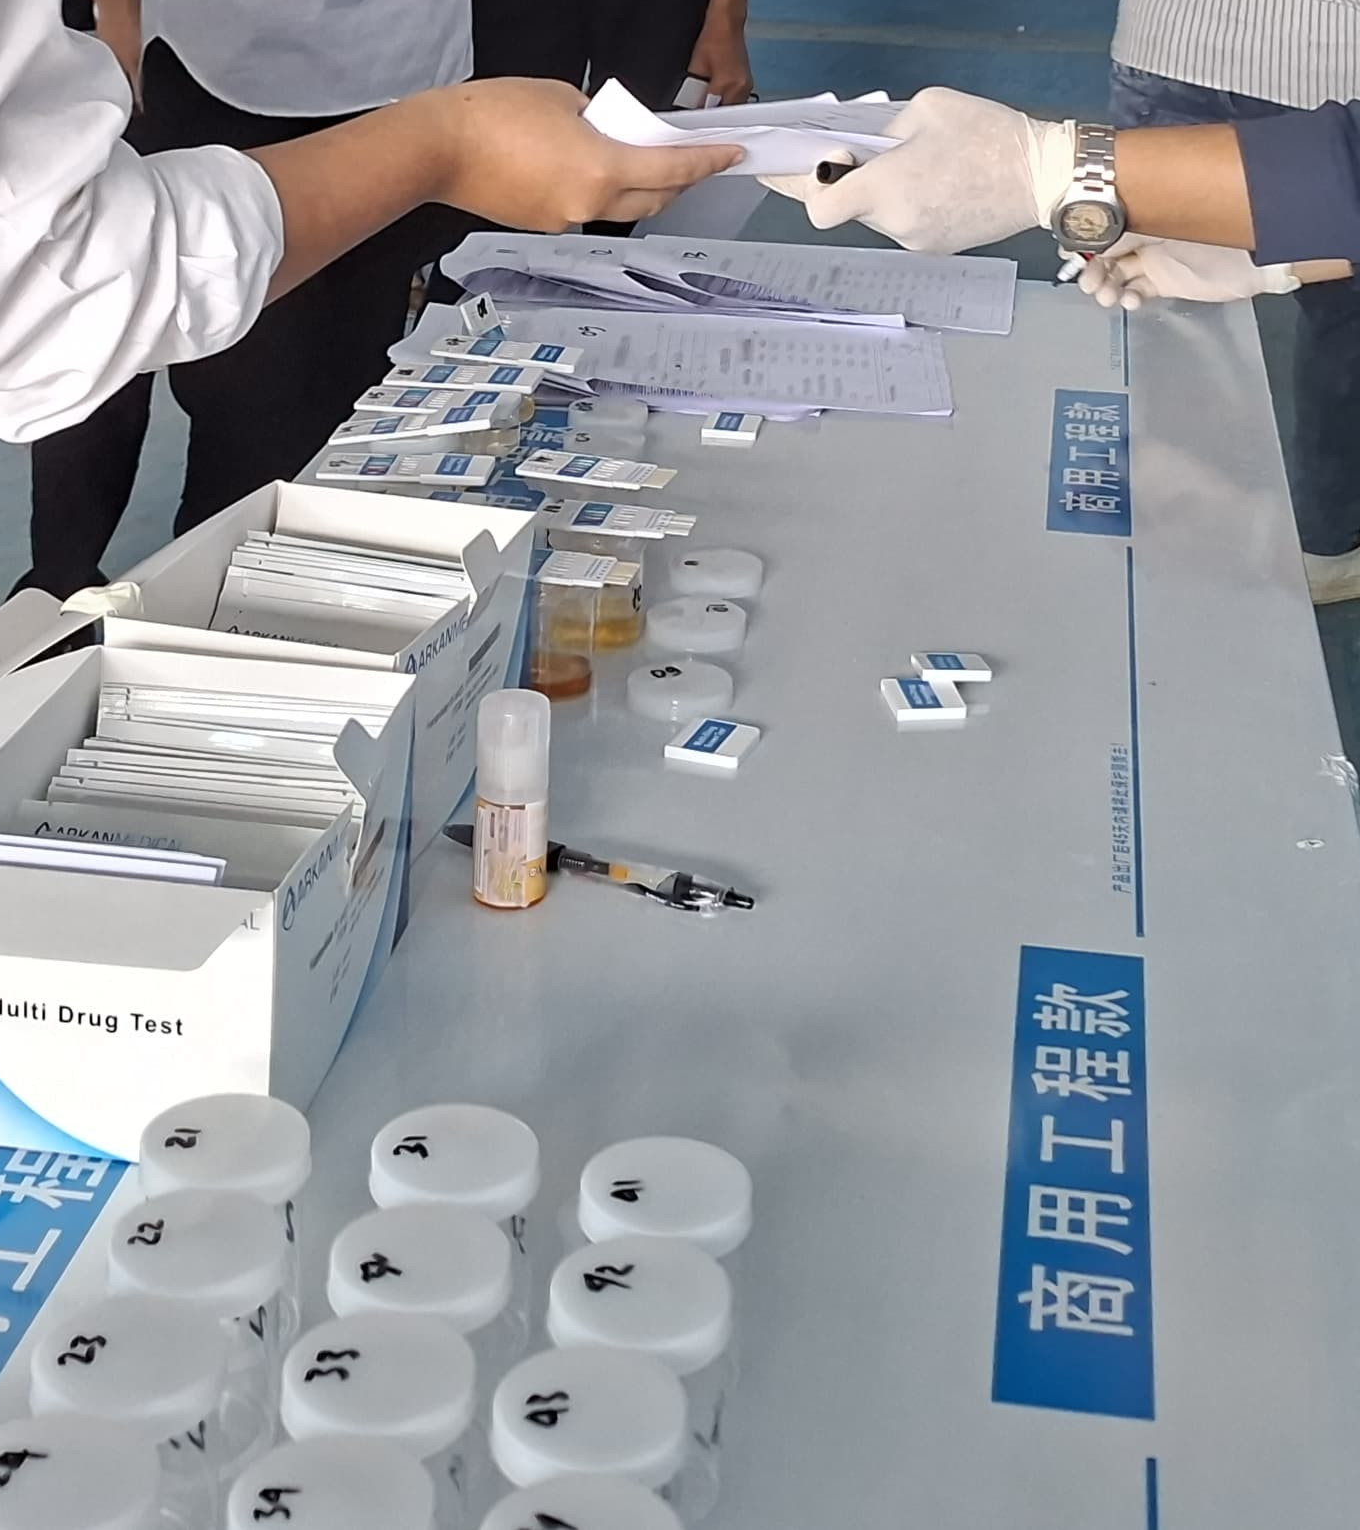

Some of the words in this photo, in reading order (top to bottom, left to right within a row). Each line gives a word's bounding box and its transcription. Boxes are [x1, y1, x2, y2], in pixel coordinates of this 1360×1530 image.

[1059, 402, 1121, 514] 商用工程款
[58, 1005, 119, 1034] Drug
[130, 1013, 184, 1036] Test
[1017, 982, 1135, 1337] 商用工程款
[127, 1218, 166, 1246] 22
[57, 1334, 108, 1366] 23
